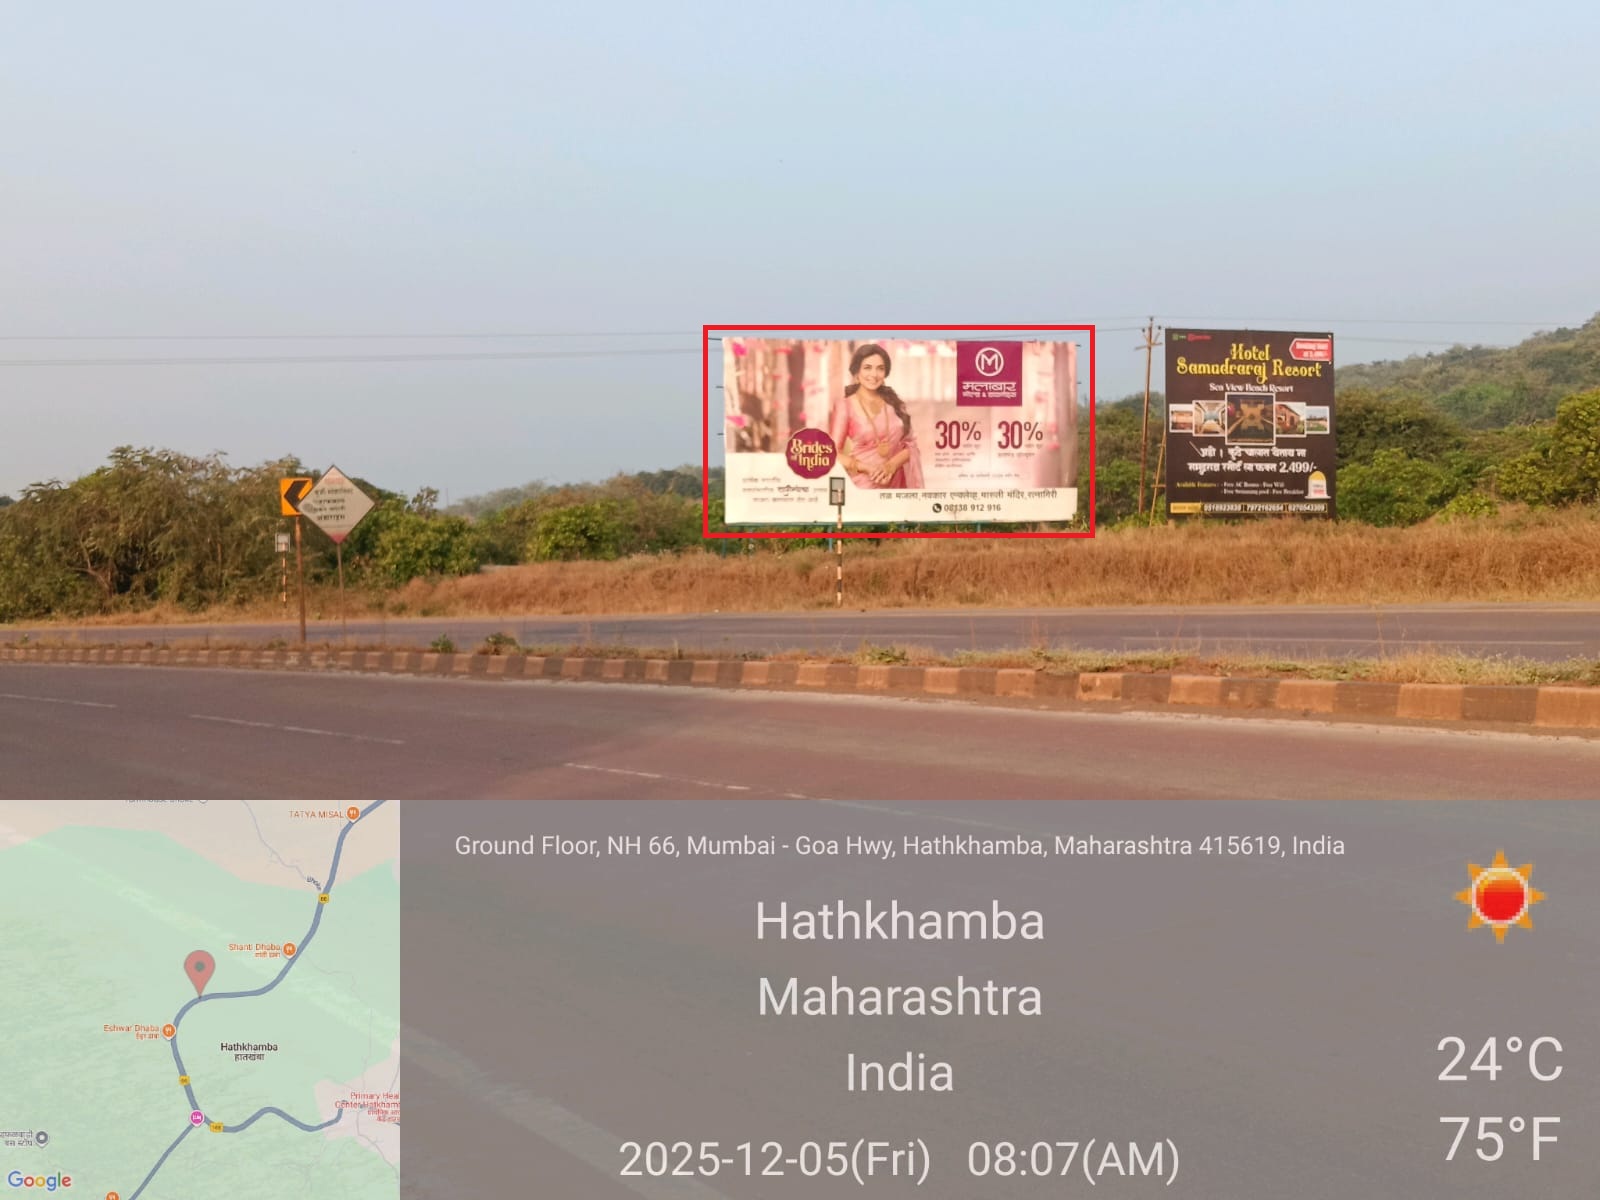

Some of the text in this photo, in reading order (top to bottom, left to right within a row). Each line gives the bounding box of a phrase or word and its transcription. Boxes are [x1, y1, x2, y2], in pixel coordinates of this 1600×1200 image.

[1230, 343, 1271, 361] Hotel
[1272, 359, 1322, 377] Resort
[962, 381, 1017, 392] मलाबार
[1225, 383, 1244, 392] View
[935, 420, 982, 449] 30%
[997, 420, 1044, 449] 30%
[790, 438, 833, 454] Brides
[798, 453, 830, 472] India
[970, 503, 985, 512] 912
[987, 503, 1002, 512] 916
